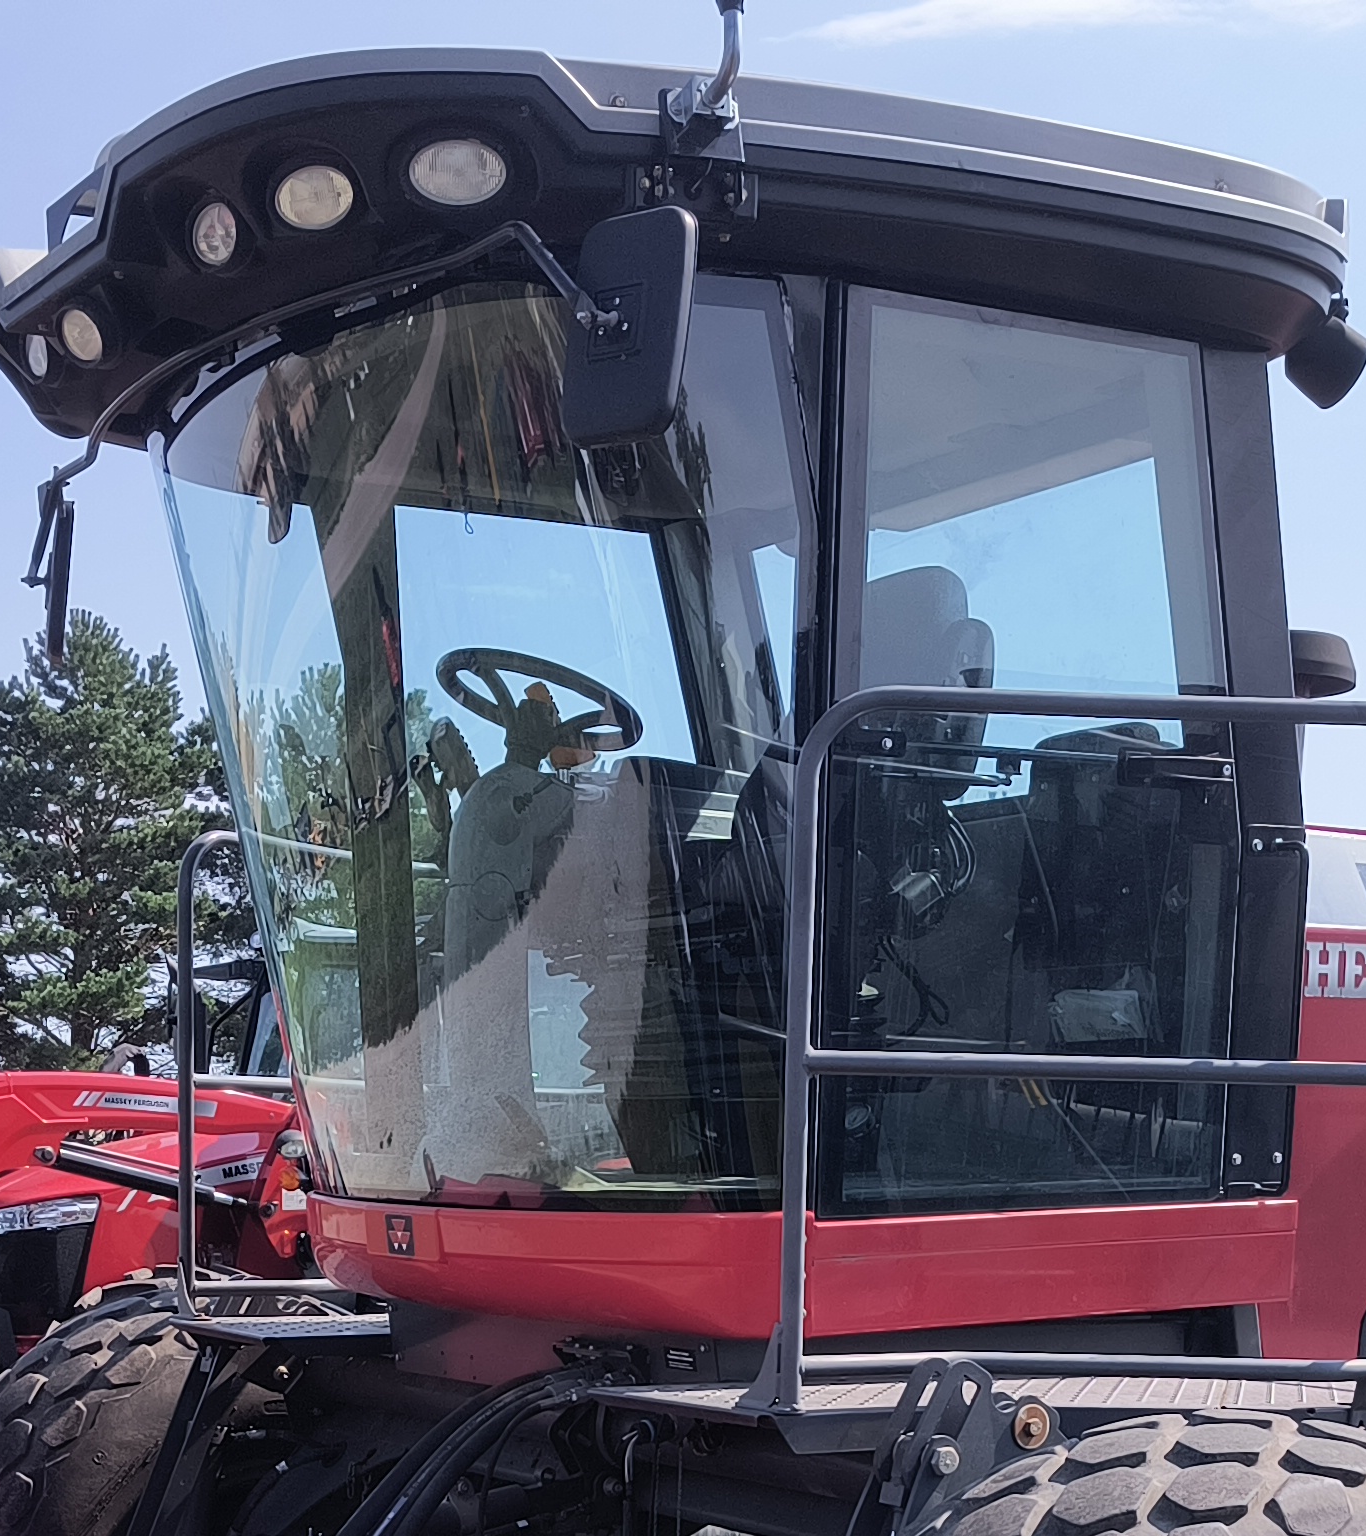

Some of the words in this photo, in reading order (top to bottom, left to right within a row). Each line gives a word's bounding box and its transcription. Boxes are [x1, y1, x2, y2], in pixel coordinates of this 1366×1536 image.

[104, 1096, 132, 1106] MASSEY
[134, 1099, 170, 1109] FERGUSON
[222, 1161, 262, 1179] MASS
